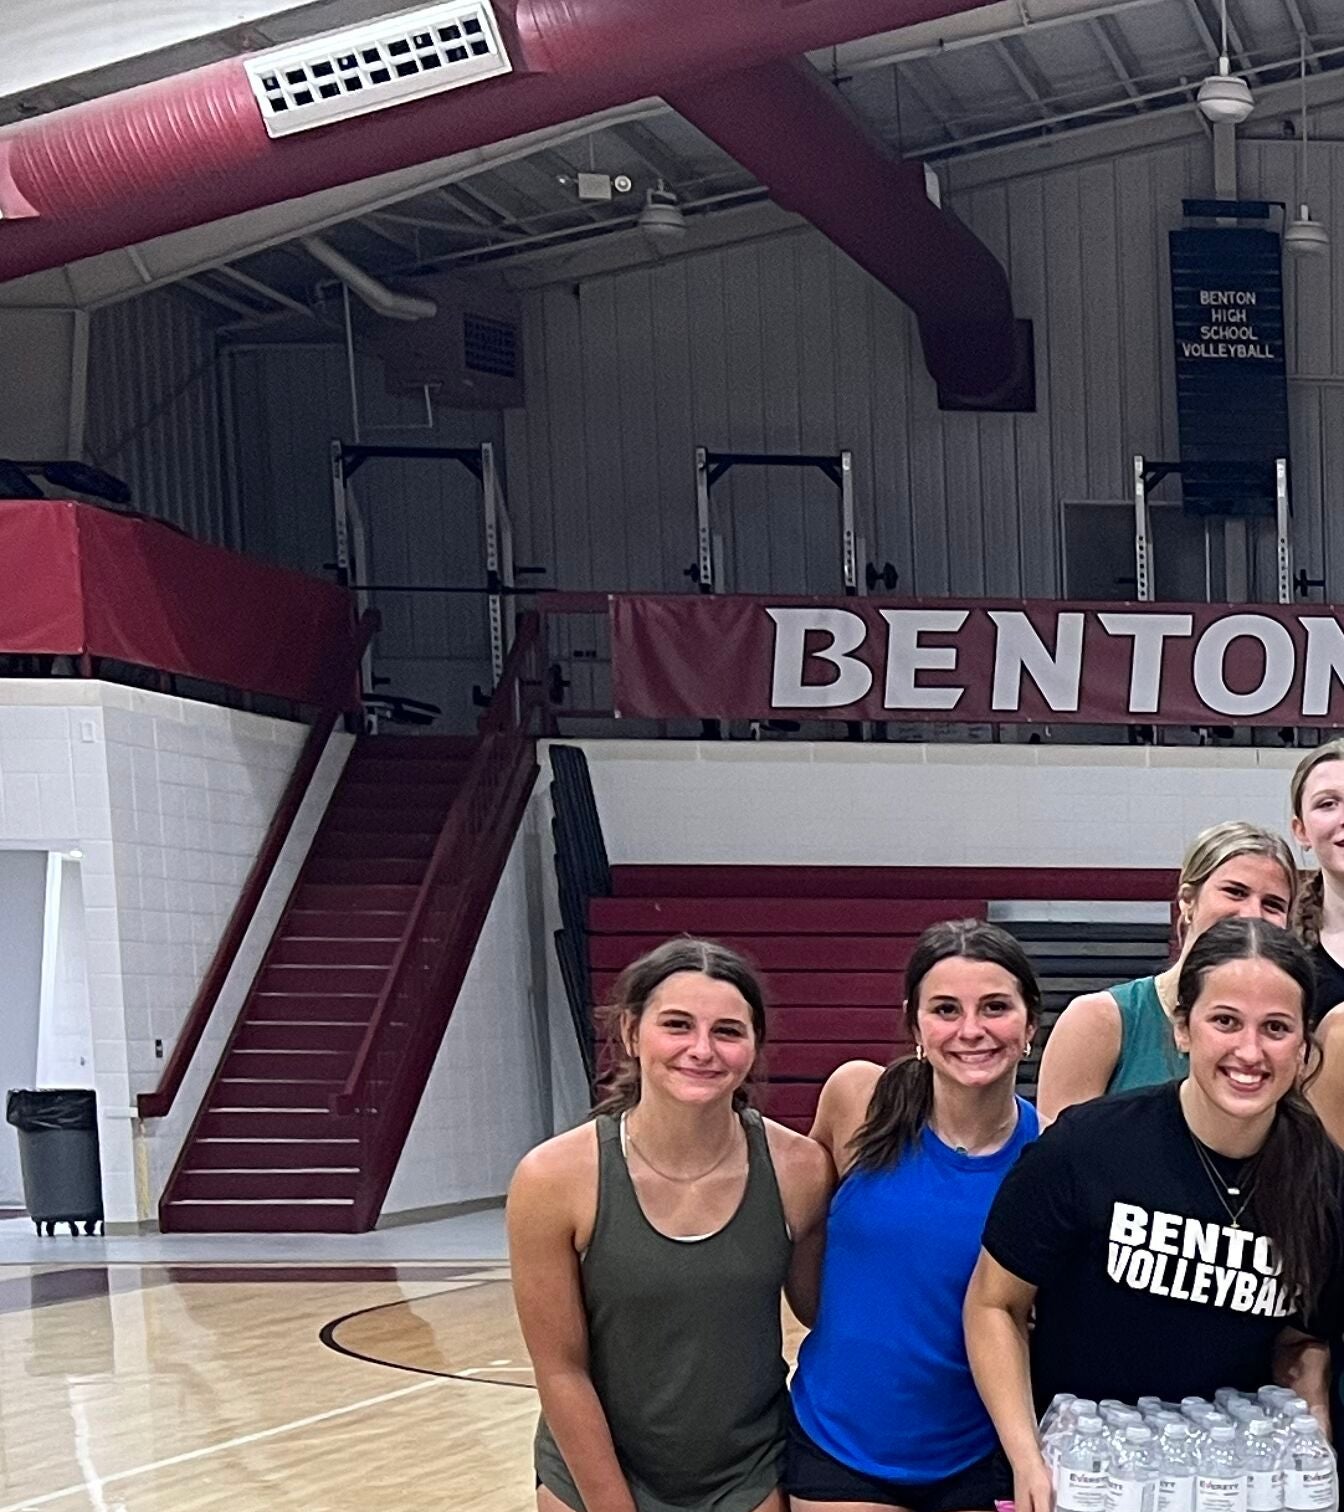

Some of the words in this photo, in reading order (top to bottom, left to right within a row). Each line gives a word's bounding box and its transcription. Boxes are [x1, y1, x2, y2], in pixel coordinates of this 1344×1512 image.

[1200, 290, 1256, 305] BENTON
[1211, 308, 1247, 322] HIGH
[1200, 326, 1258, 340] SCHOOL
[1182, 342, 1275, 358] VOLLEYBALL
[1109, 1201, 1283, 1277] BENTO
